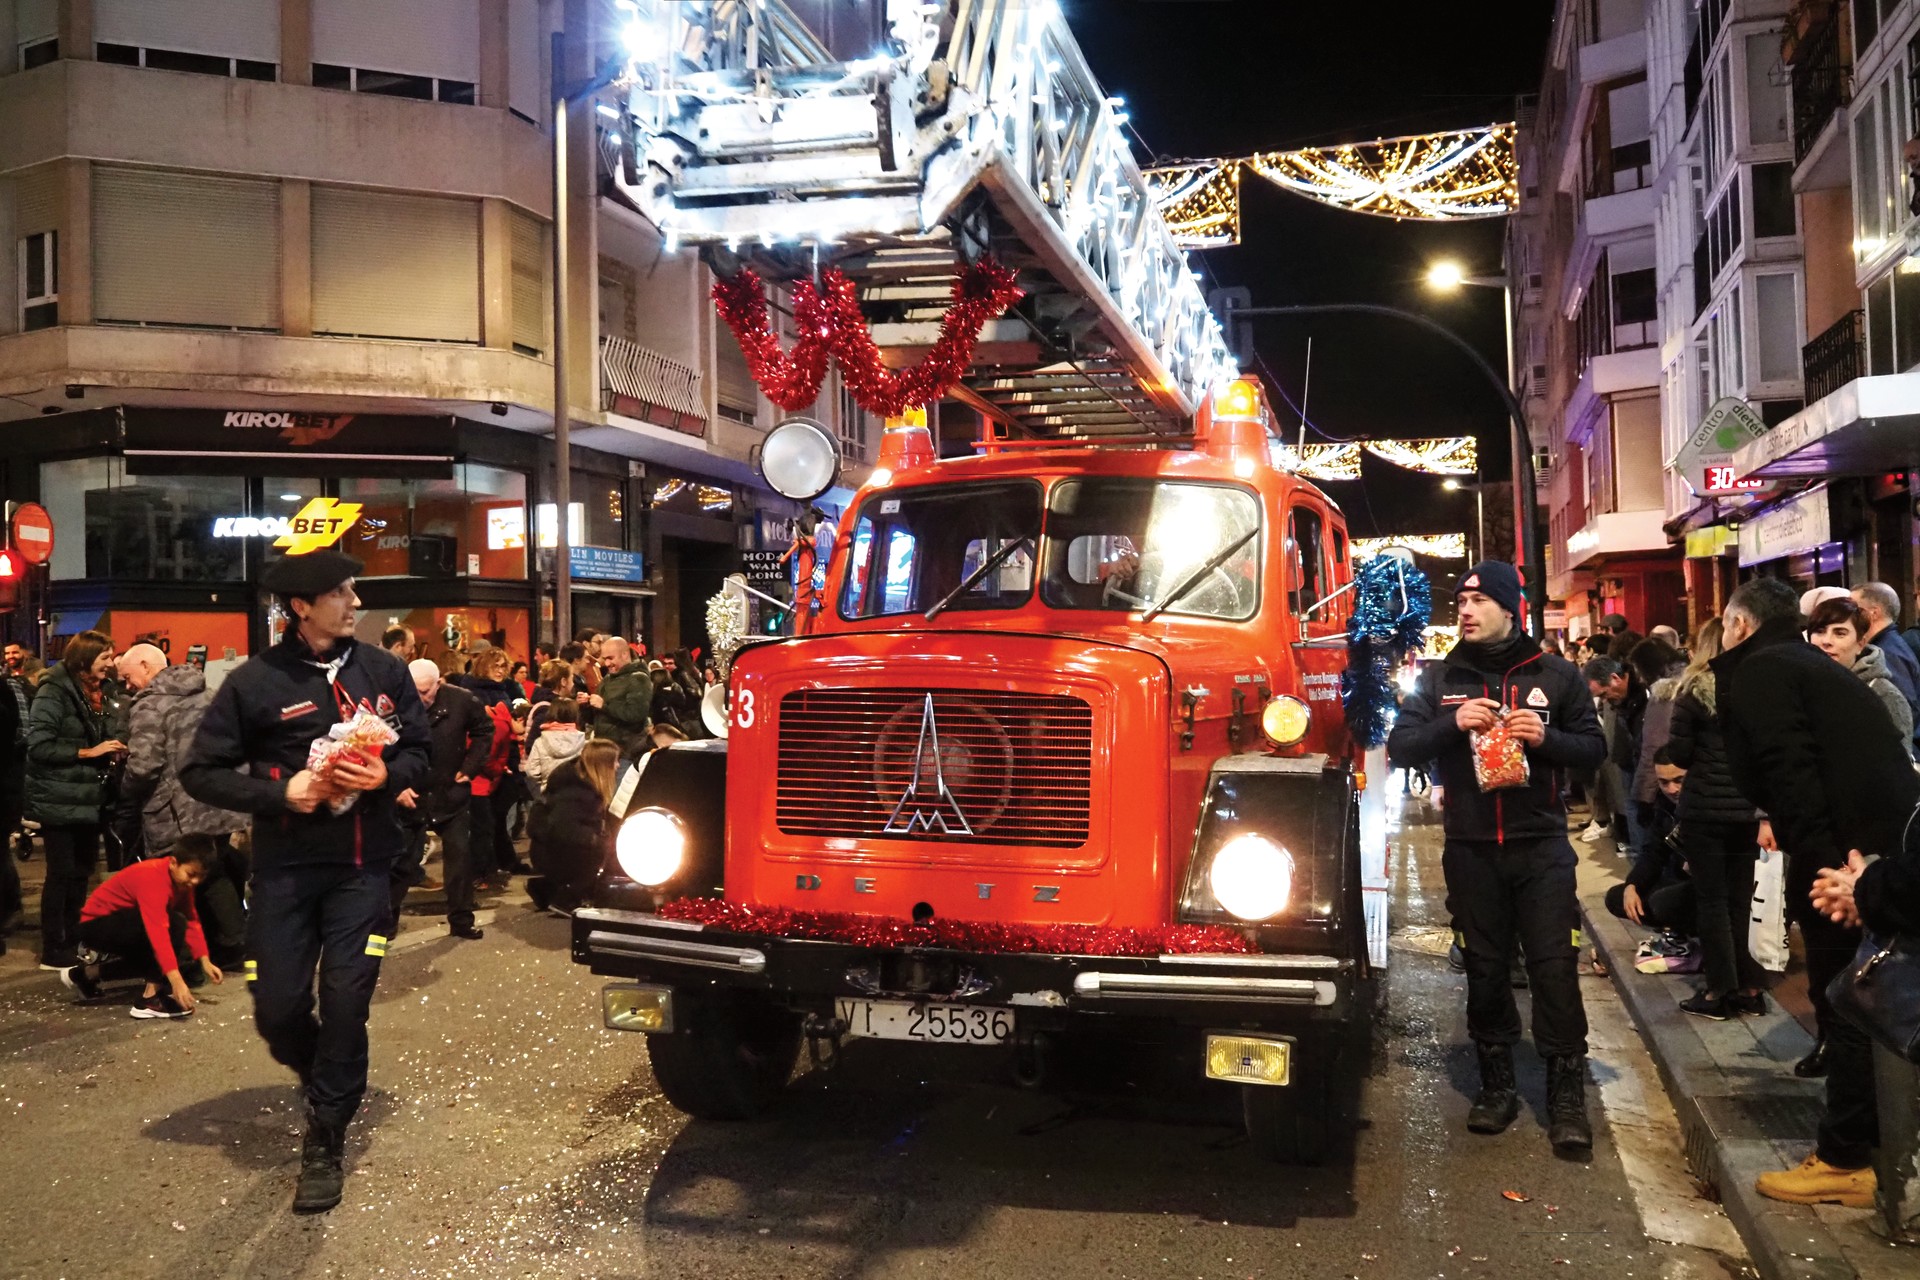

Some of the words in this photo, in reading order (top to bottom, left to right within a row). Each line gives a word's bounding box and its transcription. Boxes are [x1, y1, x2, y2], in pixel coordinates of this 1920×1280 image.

[1694, 409, 1724, 448] centro
[1732, 405, 1767, 438] dietéti
[212, 516, 343, 538] KIROLBET
[377, 535, 411, 550] KIRO
[594, 551, 634, 563] MOVILES
[907, 1006, 1011, 1040] 25536
